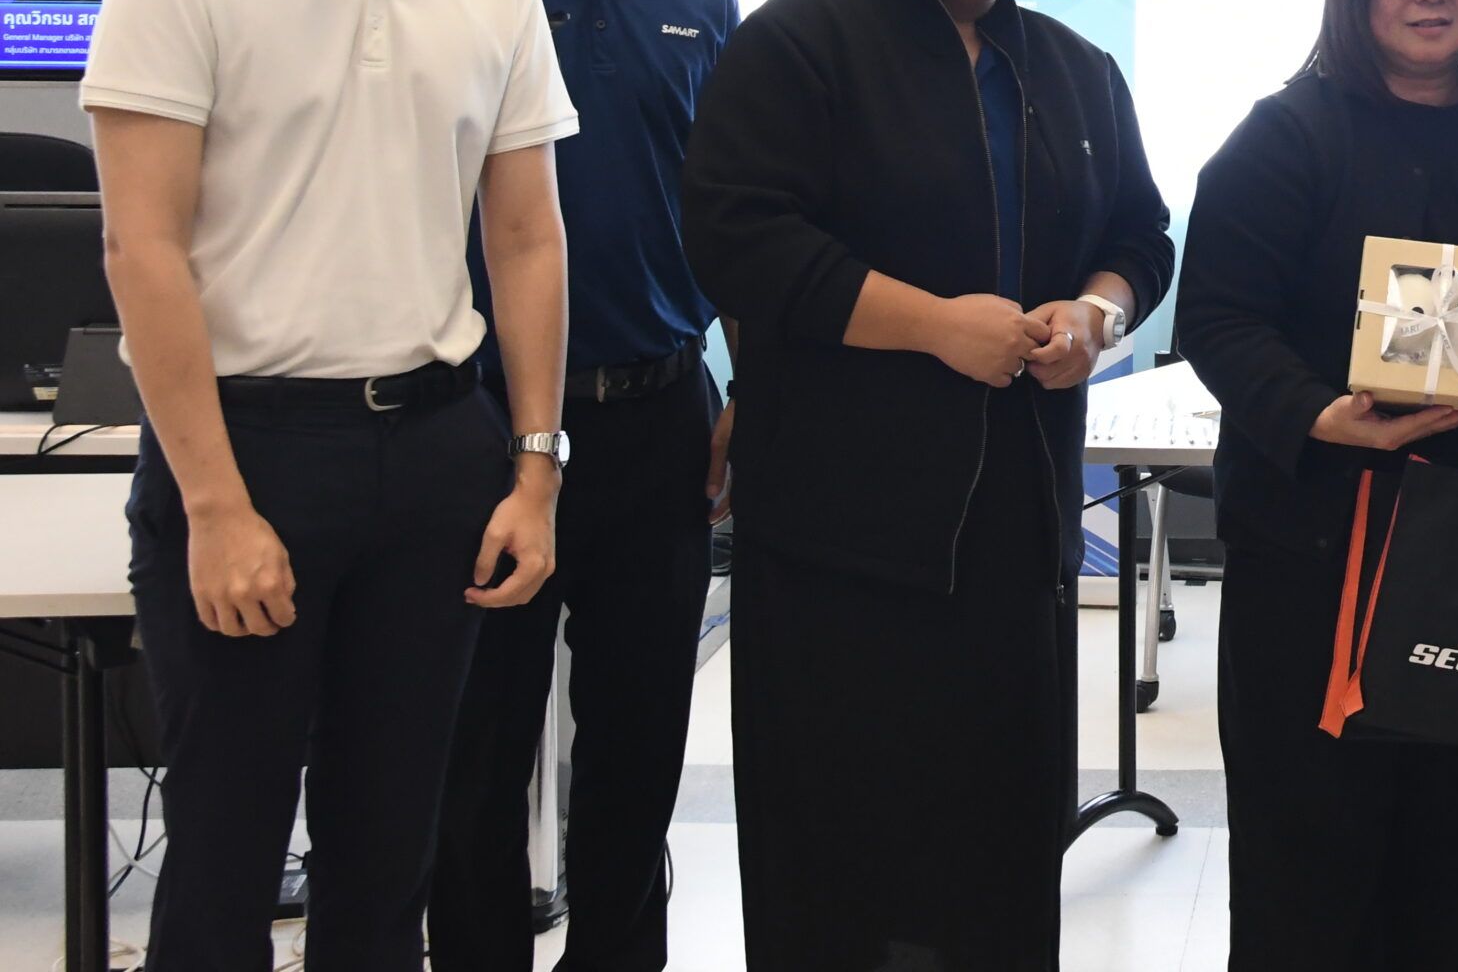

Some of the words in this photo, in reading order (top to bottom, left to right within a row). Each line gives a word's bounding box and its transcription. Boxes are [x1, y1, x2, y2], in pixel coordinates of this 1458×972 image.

[3, 10, 73, 29] คุณวิกรม
[3, 33, 31, 41] General
[32, 33, 64, 42] Manager
[661, 24, 700, 38] SAMART
